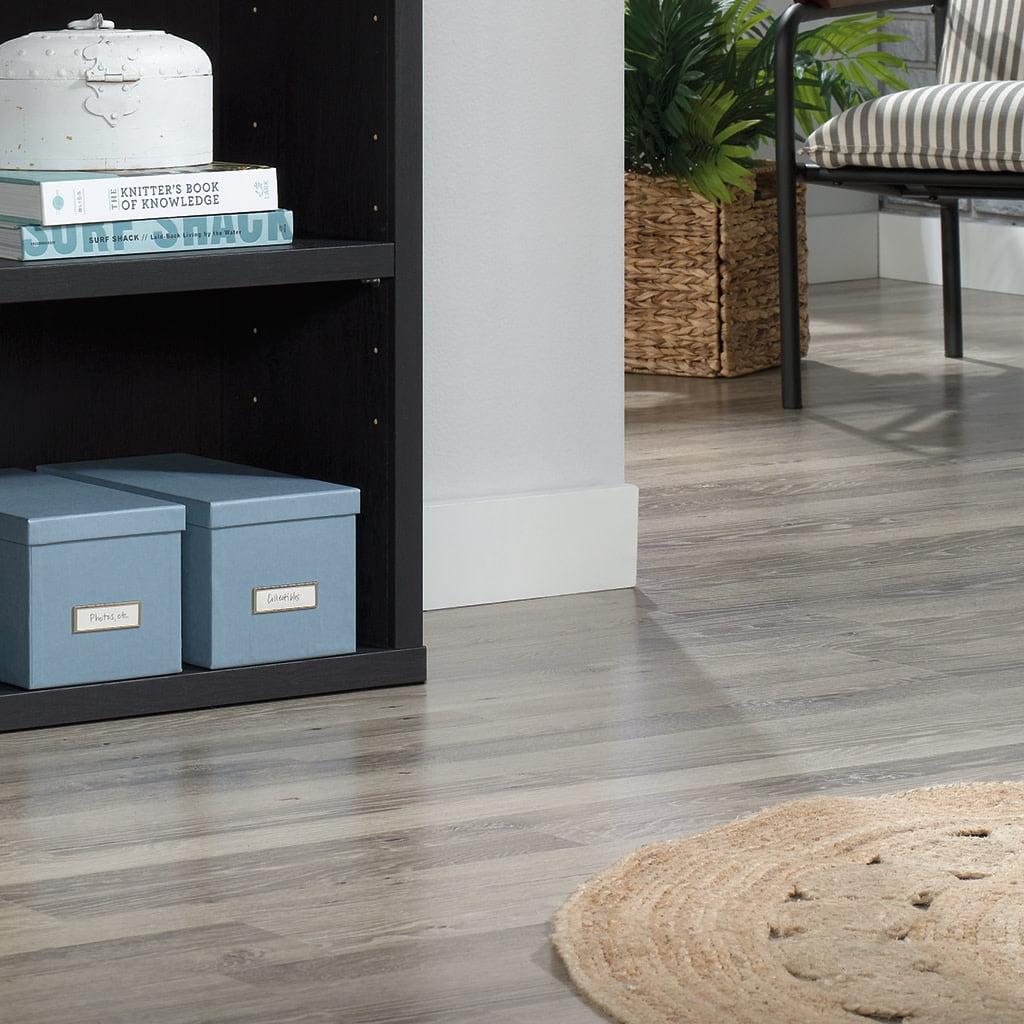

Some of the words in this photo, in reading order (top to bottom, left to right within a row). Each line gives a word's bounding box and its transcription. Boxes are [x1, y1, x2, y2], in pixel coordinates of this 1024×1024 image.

[120, 183, 182, 198] KNITTER'S
[185, 181, 220, 194] BOOK
[121, 198, 137, 210] OF
[141, 194, 220, 209] KNOWLEDGE
[88, 236, 110, 244] SURF
[112, 234, 140, 242] SHACK
